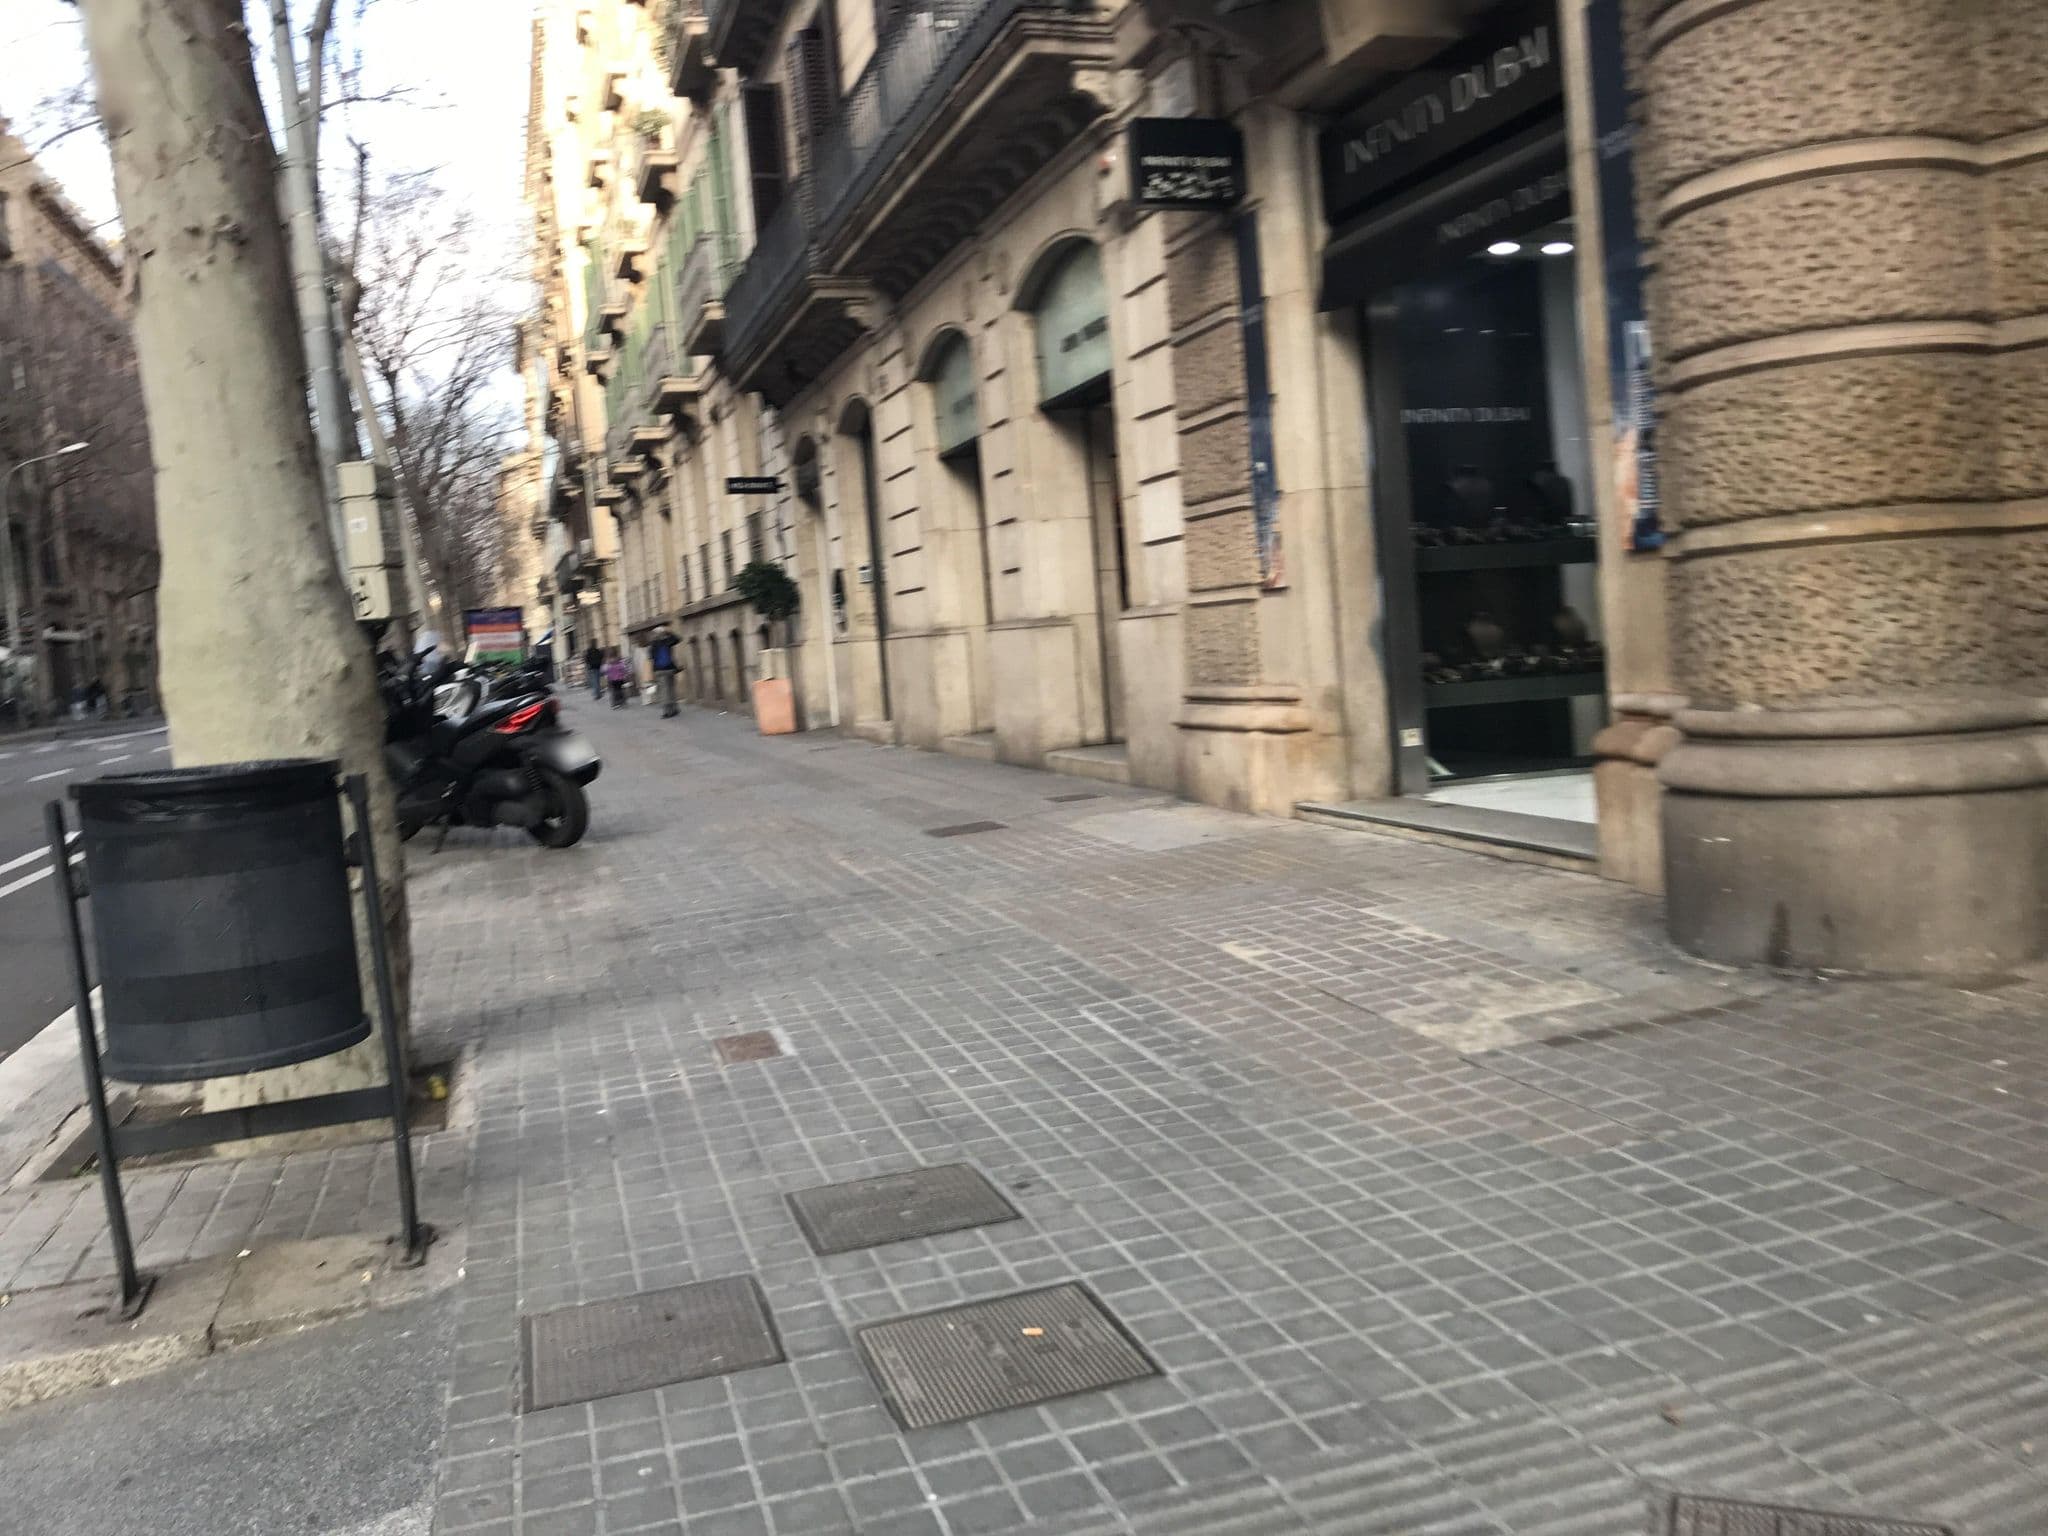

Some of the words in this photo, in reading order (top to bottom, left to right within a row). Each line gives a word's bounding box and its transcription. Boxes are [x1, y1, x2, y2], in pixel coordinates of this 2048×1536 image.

[1343, 93, 1445, 174] INFINITY
[1450, 26, 1550, 112] DUBAI
[1400, 408, 1471, 423] INFINITY
[1472, 407, 1530, 422] DUBAI
